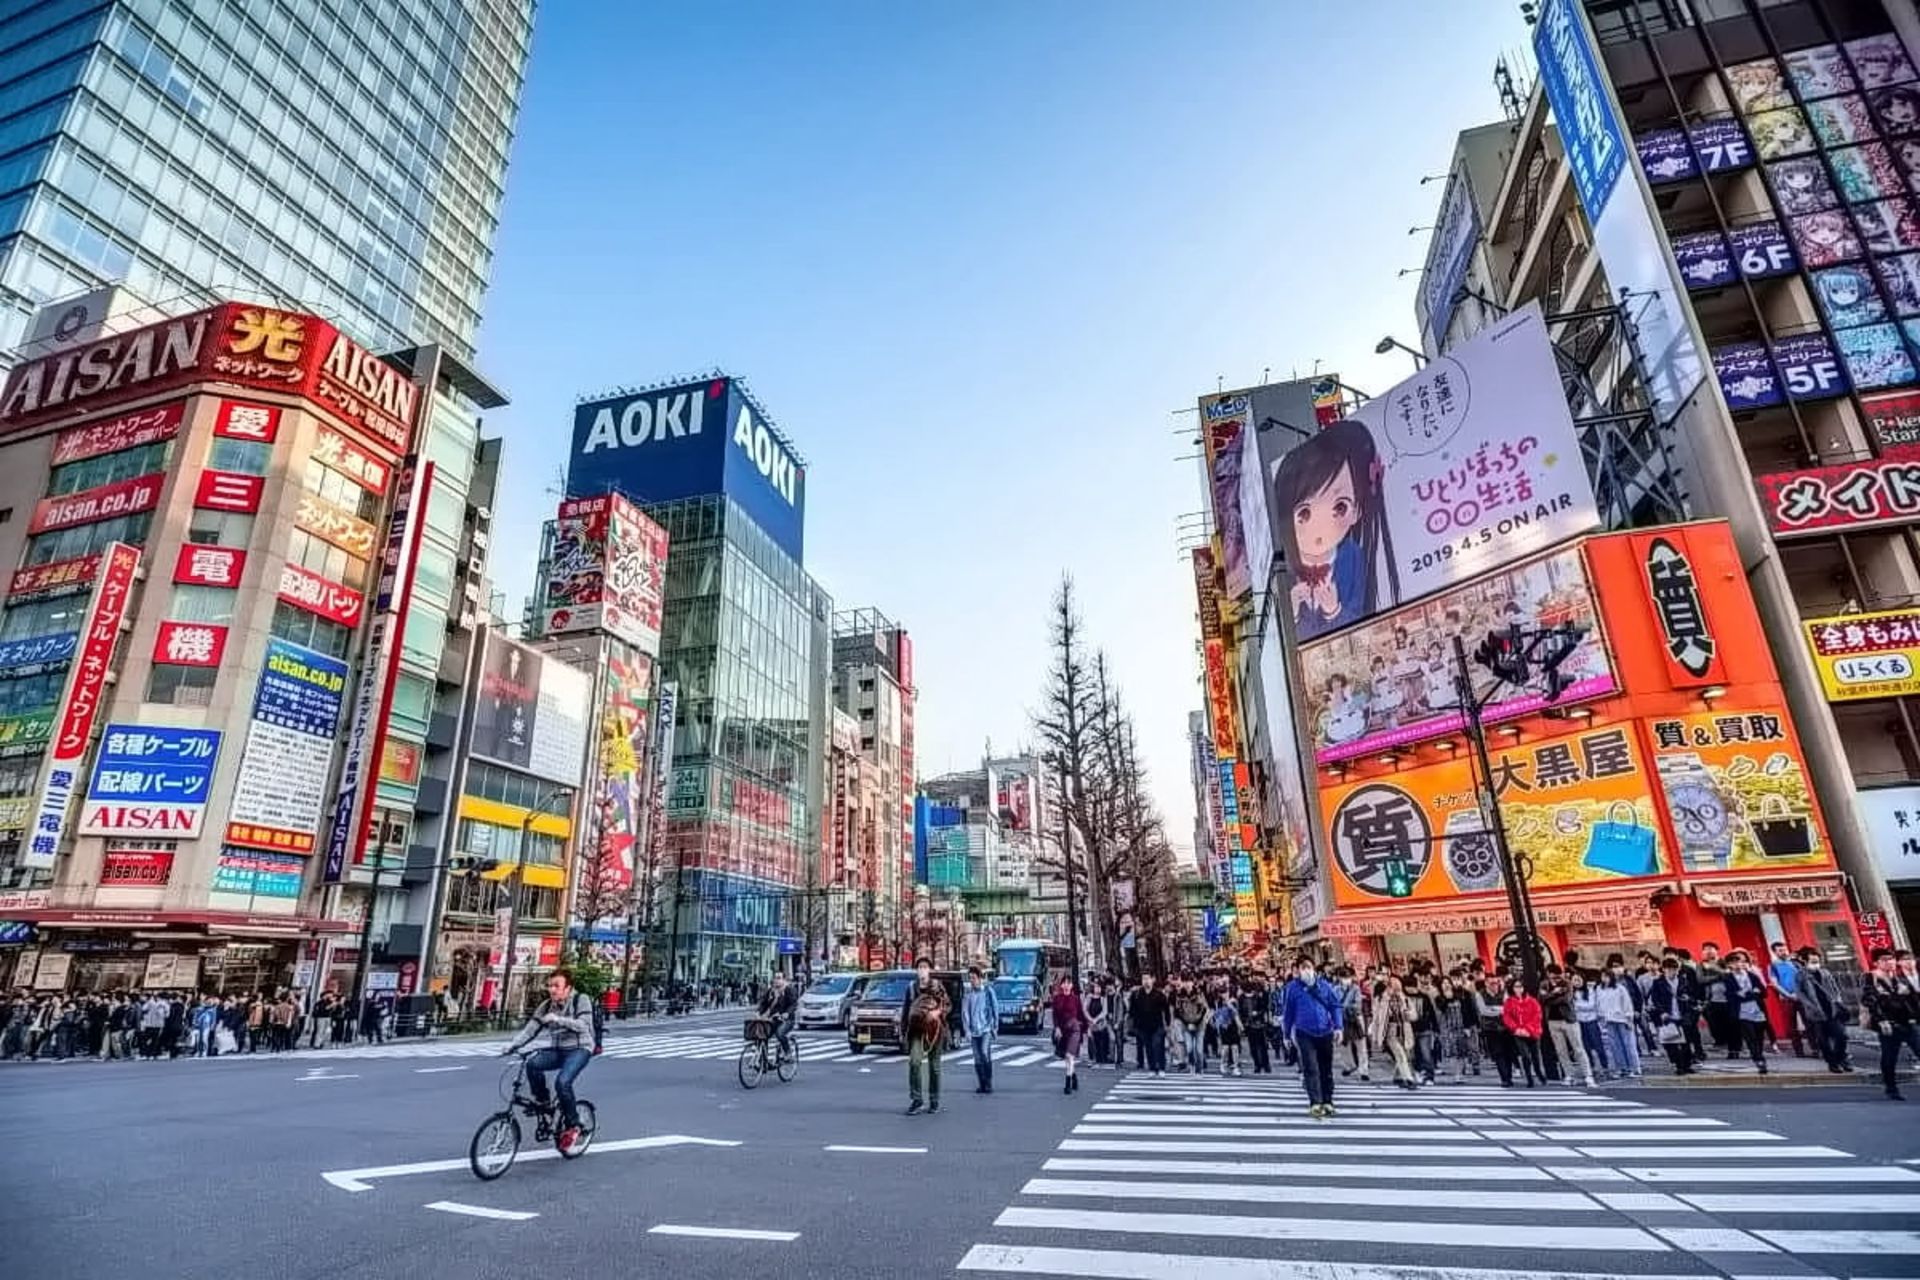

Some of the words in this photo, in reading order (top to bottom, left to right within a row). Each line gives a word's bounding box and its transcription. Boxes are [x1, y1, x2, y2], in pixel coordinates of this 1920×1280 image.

[1700, 141, 1749, 170] 7F
[1741, 244, 1791, 274] 6F
[229, 309, 305, 362] 光
[2, 315, 210, 417] AISAN
[213, 355, 305, 383] ネットワーク
[323, 334, 413, 424] AISAN
[1786, 361, 1838, 393] 5F
[226, 405, 270, 438] 愛
[583, 391, 704, 454] AOKI
[312, 431, 385, 489] 光通信
[733, 405, 796, 507] AOKI
[1411, 435, 1538, 503] ひとりぼっちの
[45, 486, 151, 524] aisan.co.jp
[207, 475, 252, 507] 三
[1776, 462, 1920, 525] メイド
[296, 498, 374, 551] ネットワーク
[1411, 526, 1492, 573] 2019.4.5
[1496, 511, 1530, 536] ON
[1534, 493, 1573, 521] AIR
[190, 549, 234, 583] 電
[279, 567, 360, 618] 配線パーツ
[62, 552, 135, 749] 光・ケーブル・ネットワーク
[167, 626, 215, 661] 機
[1840, 659, 1905, 678] りらくる
[268, 655, 343, 692] aisan.co.jp
[107, 732, 213, 758] 各種ケーブル
[1491, 729, 1636, 796] 大黒屋
[97, 769, 204, 794] 配線パーツ
[32, 769, 74, 856] 愛三電機
[87, 806, 196, 830] AISAN
[327, 794, 356, 874] AISAN
[1342, 796, 1424, 879] 質
